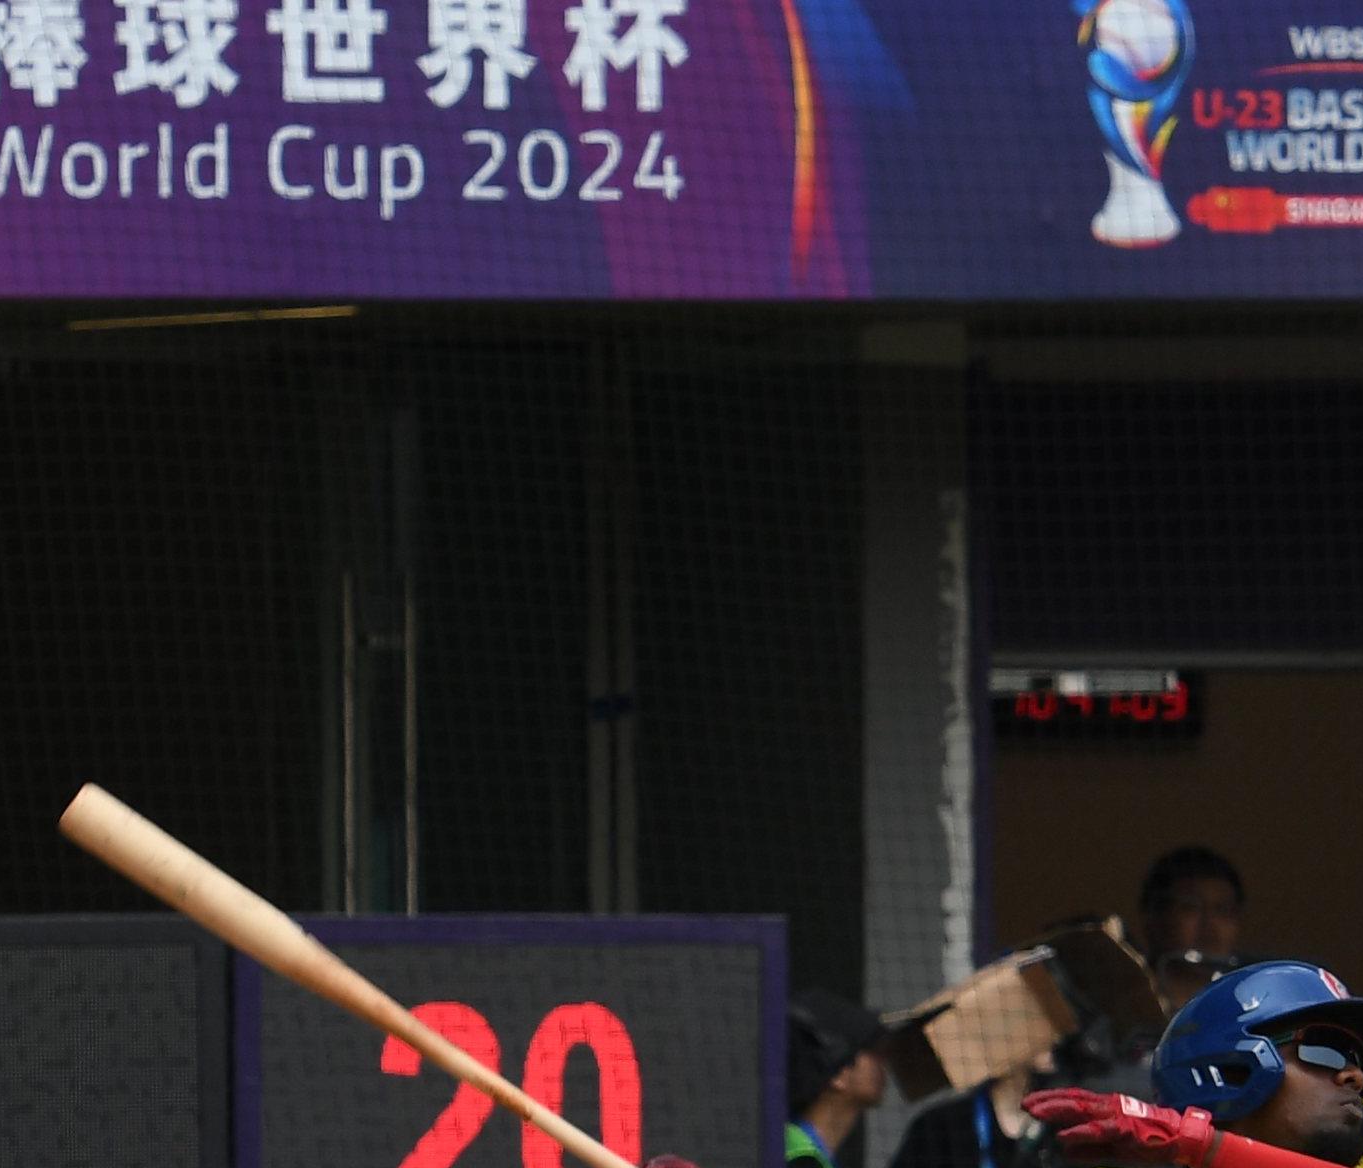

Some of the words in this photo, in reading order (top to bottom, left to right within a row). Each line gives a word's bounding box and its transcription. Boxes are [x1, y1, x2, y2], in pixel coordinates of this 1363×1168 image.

[1192, 89, 1283, 128] U-23
[267, 125, 425, 220] Cup
[462, 130, 684, 202] 2024
